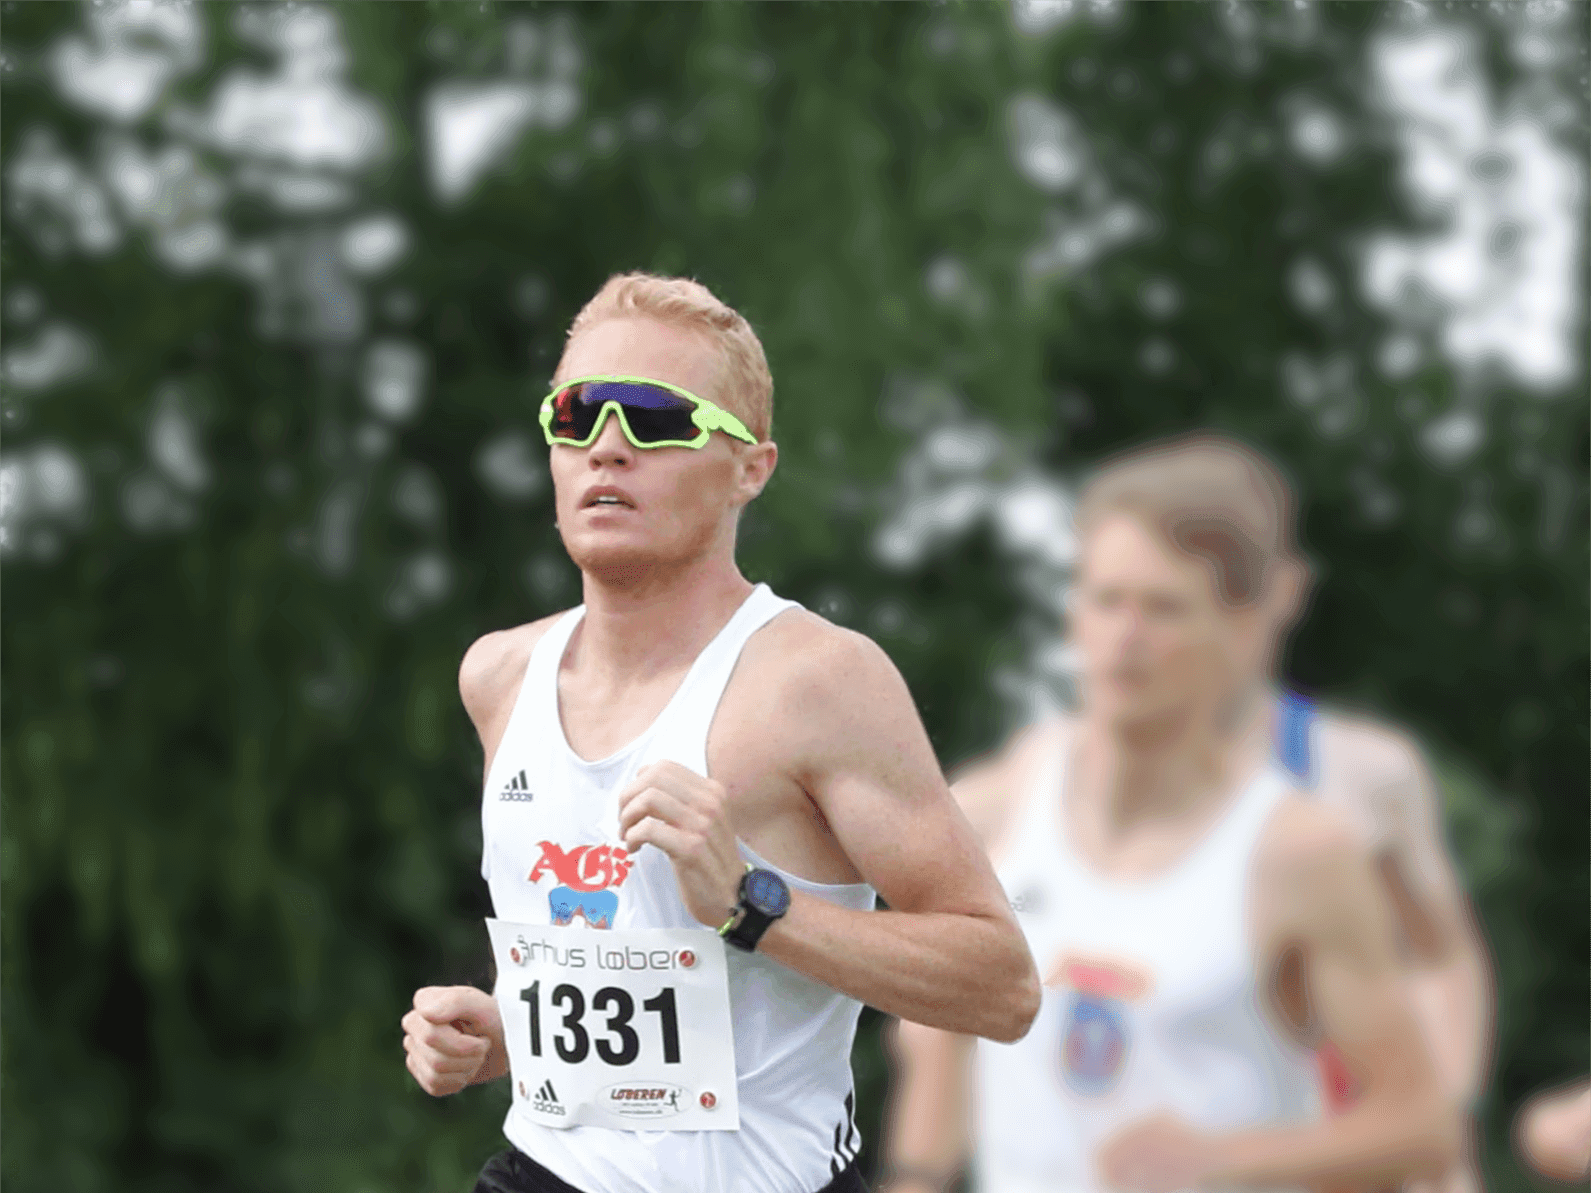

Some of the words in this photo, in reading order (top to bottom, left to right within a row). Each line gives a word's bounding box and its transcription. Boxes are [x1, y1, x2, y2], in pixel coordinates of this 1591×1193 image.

[499, 791, 534, 803] adidas
[519, 979, 681, 1067] 1331
[532, 1099, 567, 1117] adidas
